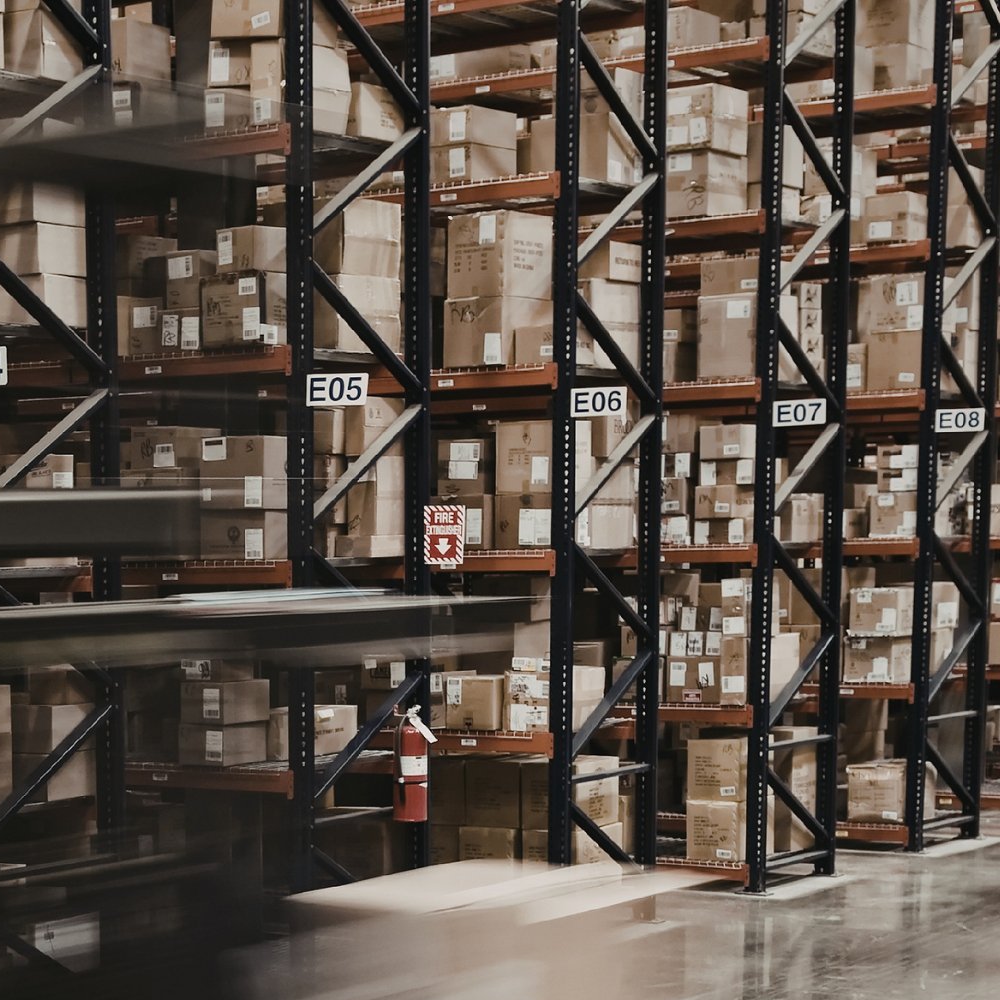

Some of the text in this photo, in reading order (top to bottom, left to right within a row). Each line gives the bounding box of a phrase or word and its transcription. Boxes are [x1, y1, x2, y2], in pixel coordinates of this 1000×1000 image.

[310, 377, 362, 401] E05
[575, 391, 621, 413] E06
[778, 403, 821, 423] E07
[940, 411, 979, 428] E08
[434, 512, 454, 523] FIRE
